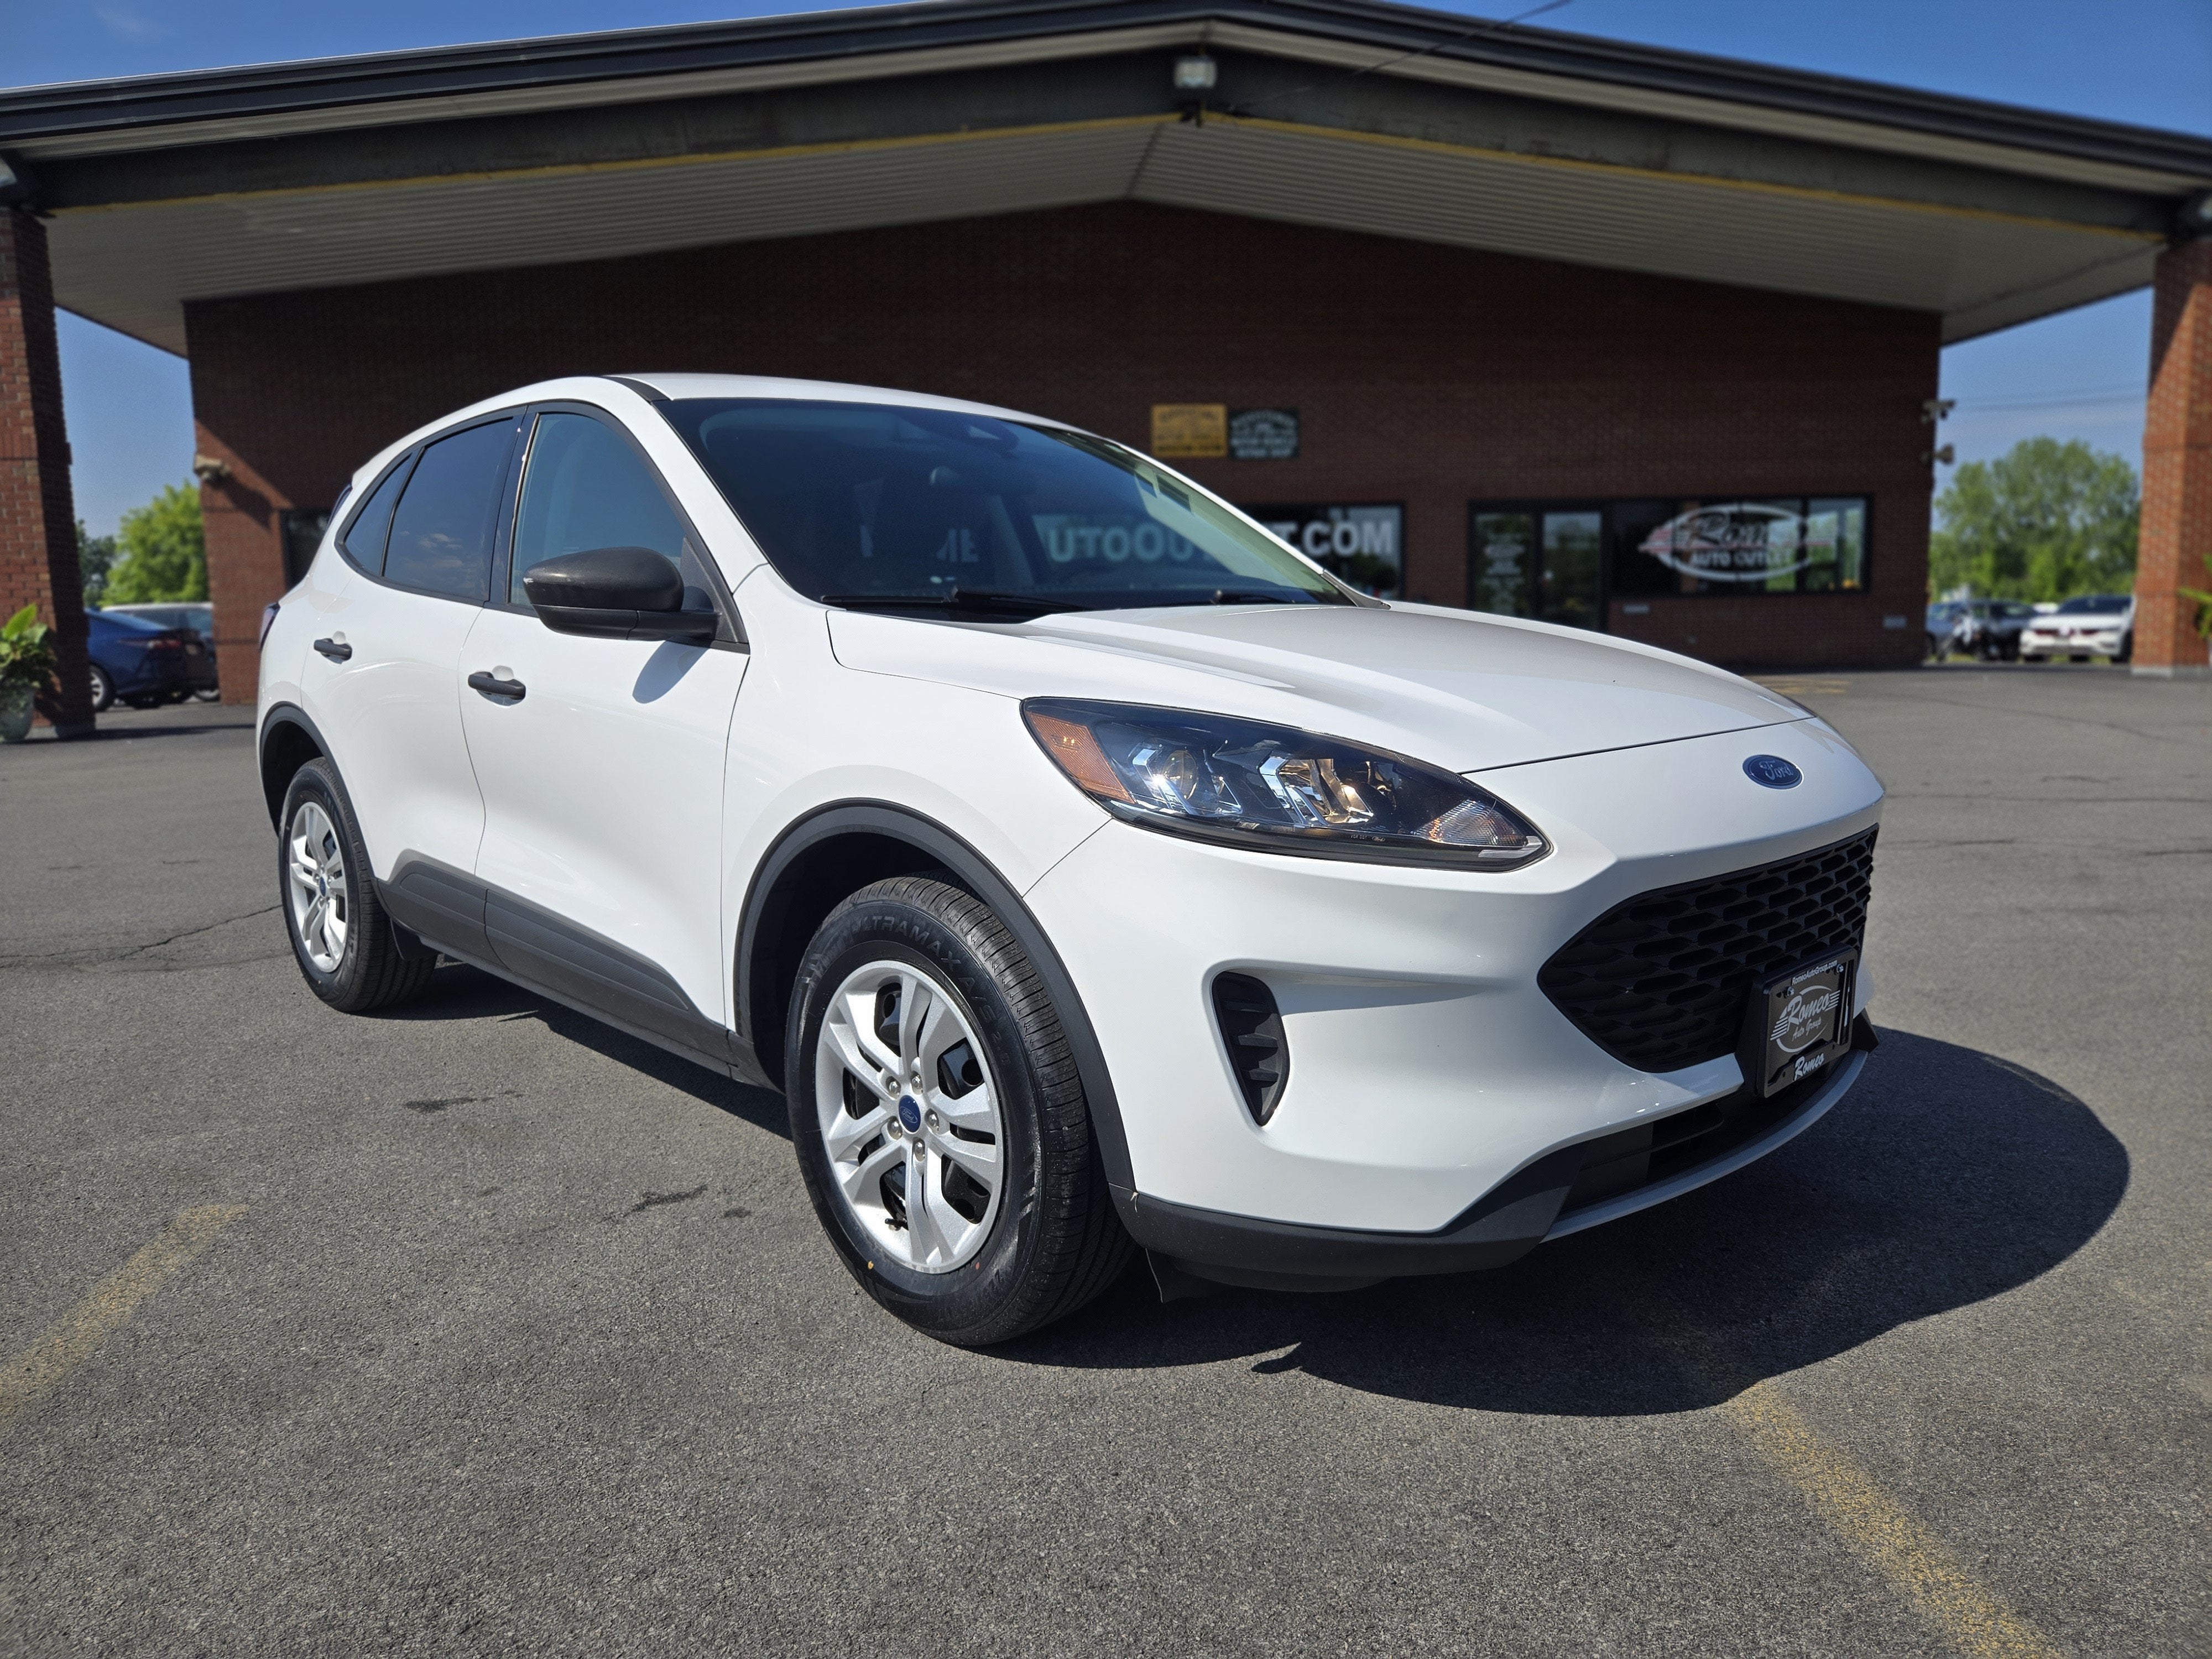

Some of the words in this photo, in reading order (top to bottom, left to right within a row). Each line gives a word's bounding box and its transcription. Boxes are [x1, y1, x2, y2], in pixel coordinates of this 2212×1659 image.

[1759, 760, 1794, 780] Ford
[1786, 993, 1831, 1033] Romeo
[1791, 1026, 1805, 1042] Auto
[1806, 1016, 1822, 1036] Group
[1794, 1052, 1824, 1081] Romeo
